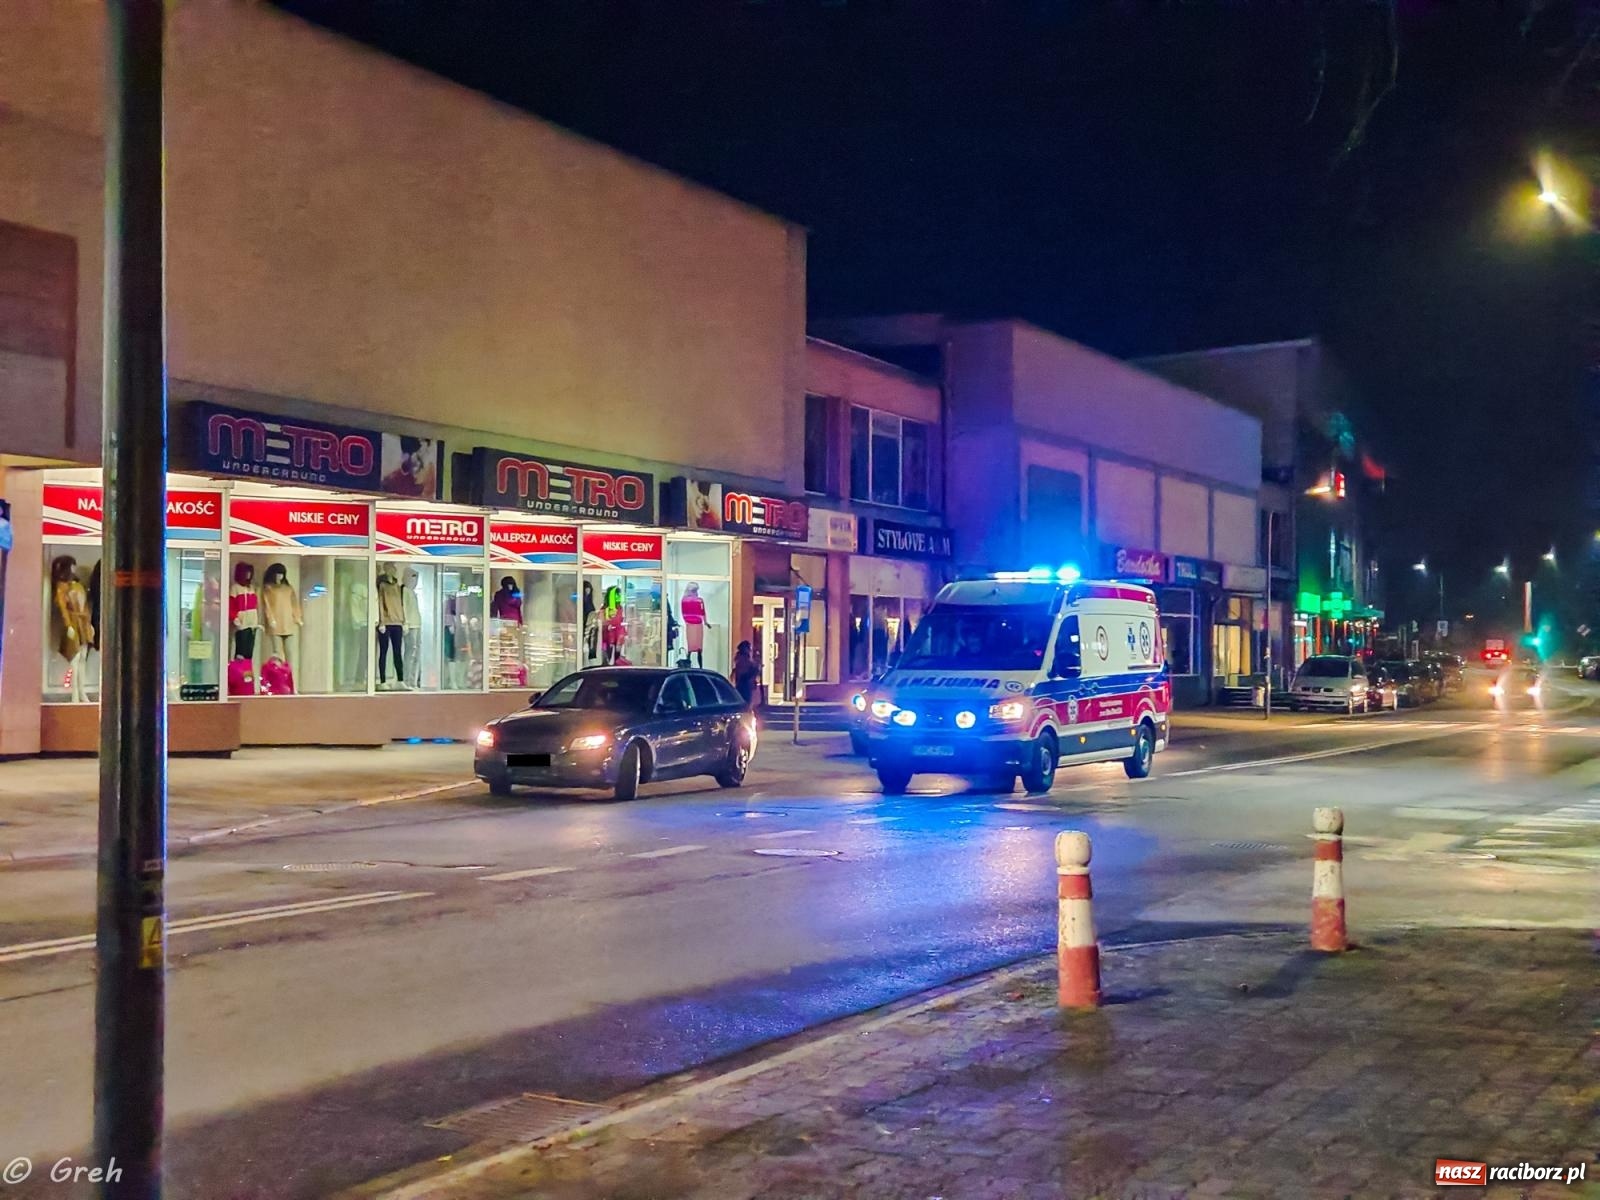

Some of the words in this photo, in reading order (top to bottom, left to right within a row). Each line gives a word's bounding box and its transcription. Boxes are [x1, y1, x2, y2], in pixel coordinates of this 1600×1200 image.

[207, 413, 374, 477] METRO
[496, 457, 645, 511] METRO
[166, 500, 215, 515] AKOŚĆ
[724, 491, 806, 531] METRO
[288, 511, 324, 524] NISKIE
[327, 512, 360, 526] CENY
[406, 518, 479, 536] METRO
[489, 532, 537, 544] NAJLEPSZA
[539, 533, 574, 545] JAKOŚĆ
[602, 541, 629, 551] NISKIE
[630, 542, 655, 552] CENY
[877, 528, 926, 552] STYLOVE
